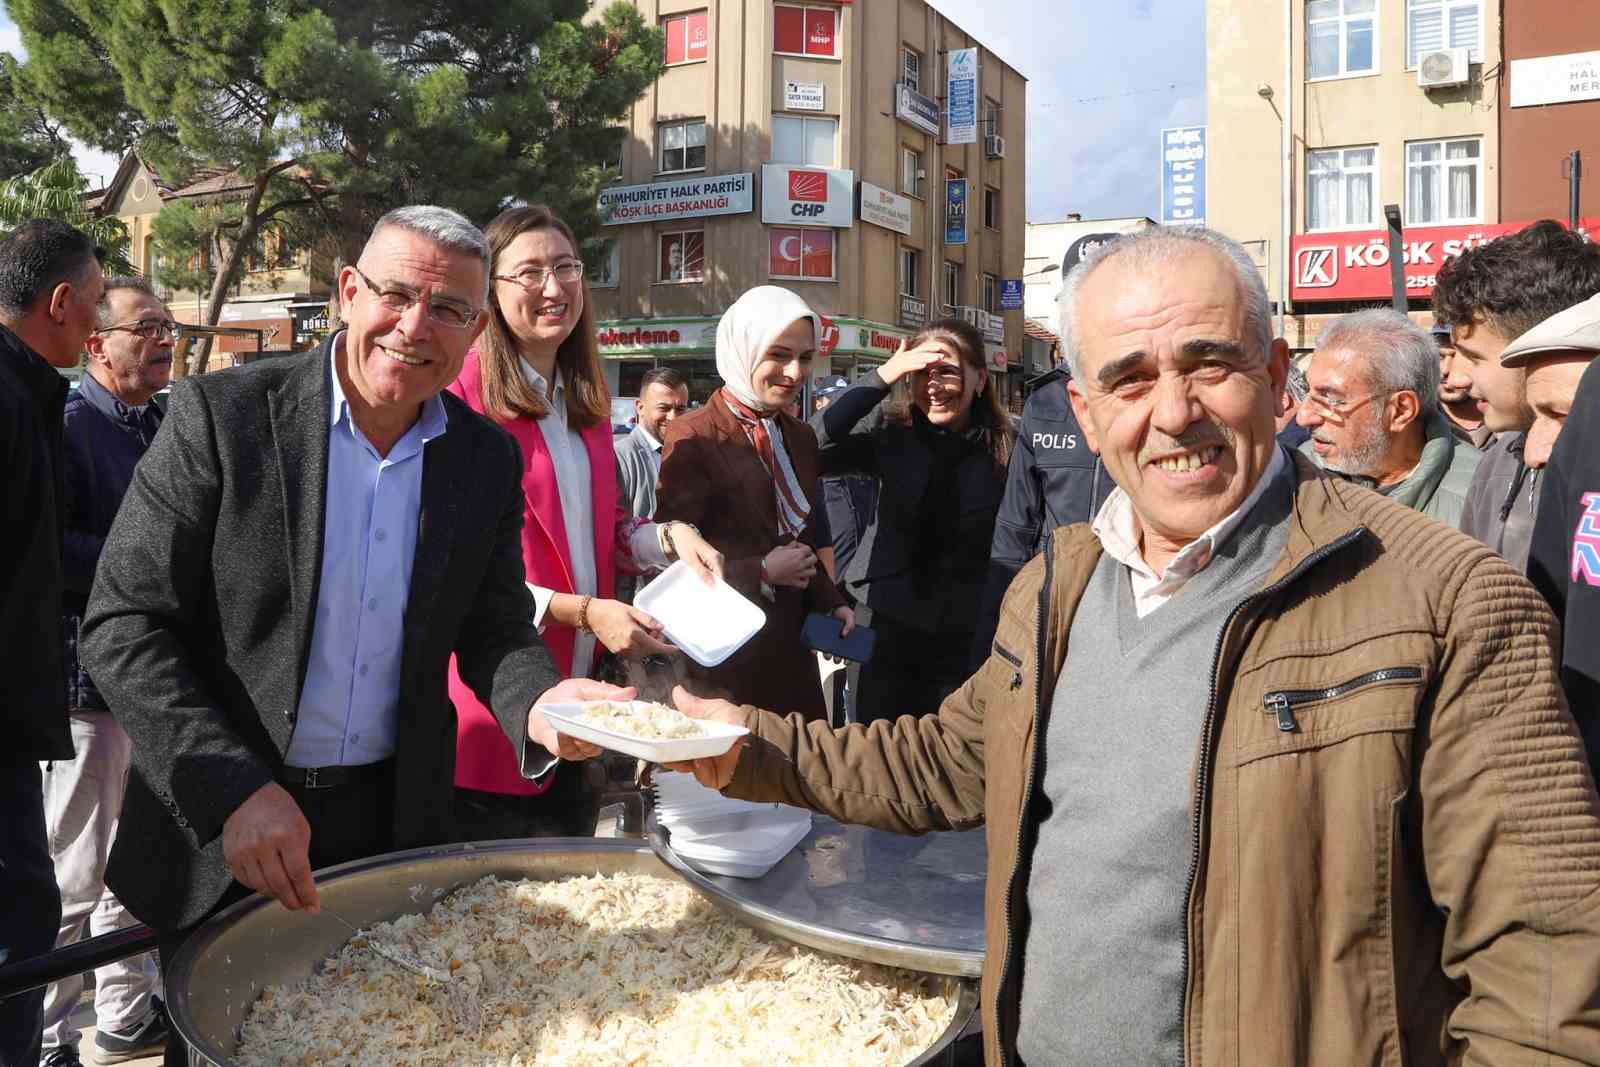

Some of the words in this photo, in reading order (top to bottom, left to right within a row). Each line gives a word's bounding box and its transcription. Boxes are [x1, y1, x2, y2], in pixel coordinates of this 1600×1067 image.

[1569, 69, 1600, 80] HAL
[600, 187, 668, 206] CUMHURİYET
[670, 184, 700, 198] HALK
[703, 176, 745, 195] PARTİSİ
[643, 202, 664, 218] İLÇE
[665, 196, 729, 215] BAŞKANLIĞI
[791, 203, 825, 216] CHP
[597, 327, 681, 346] ekerleme
